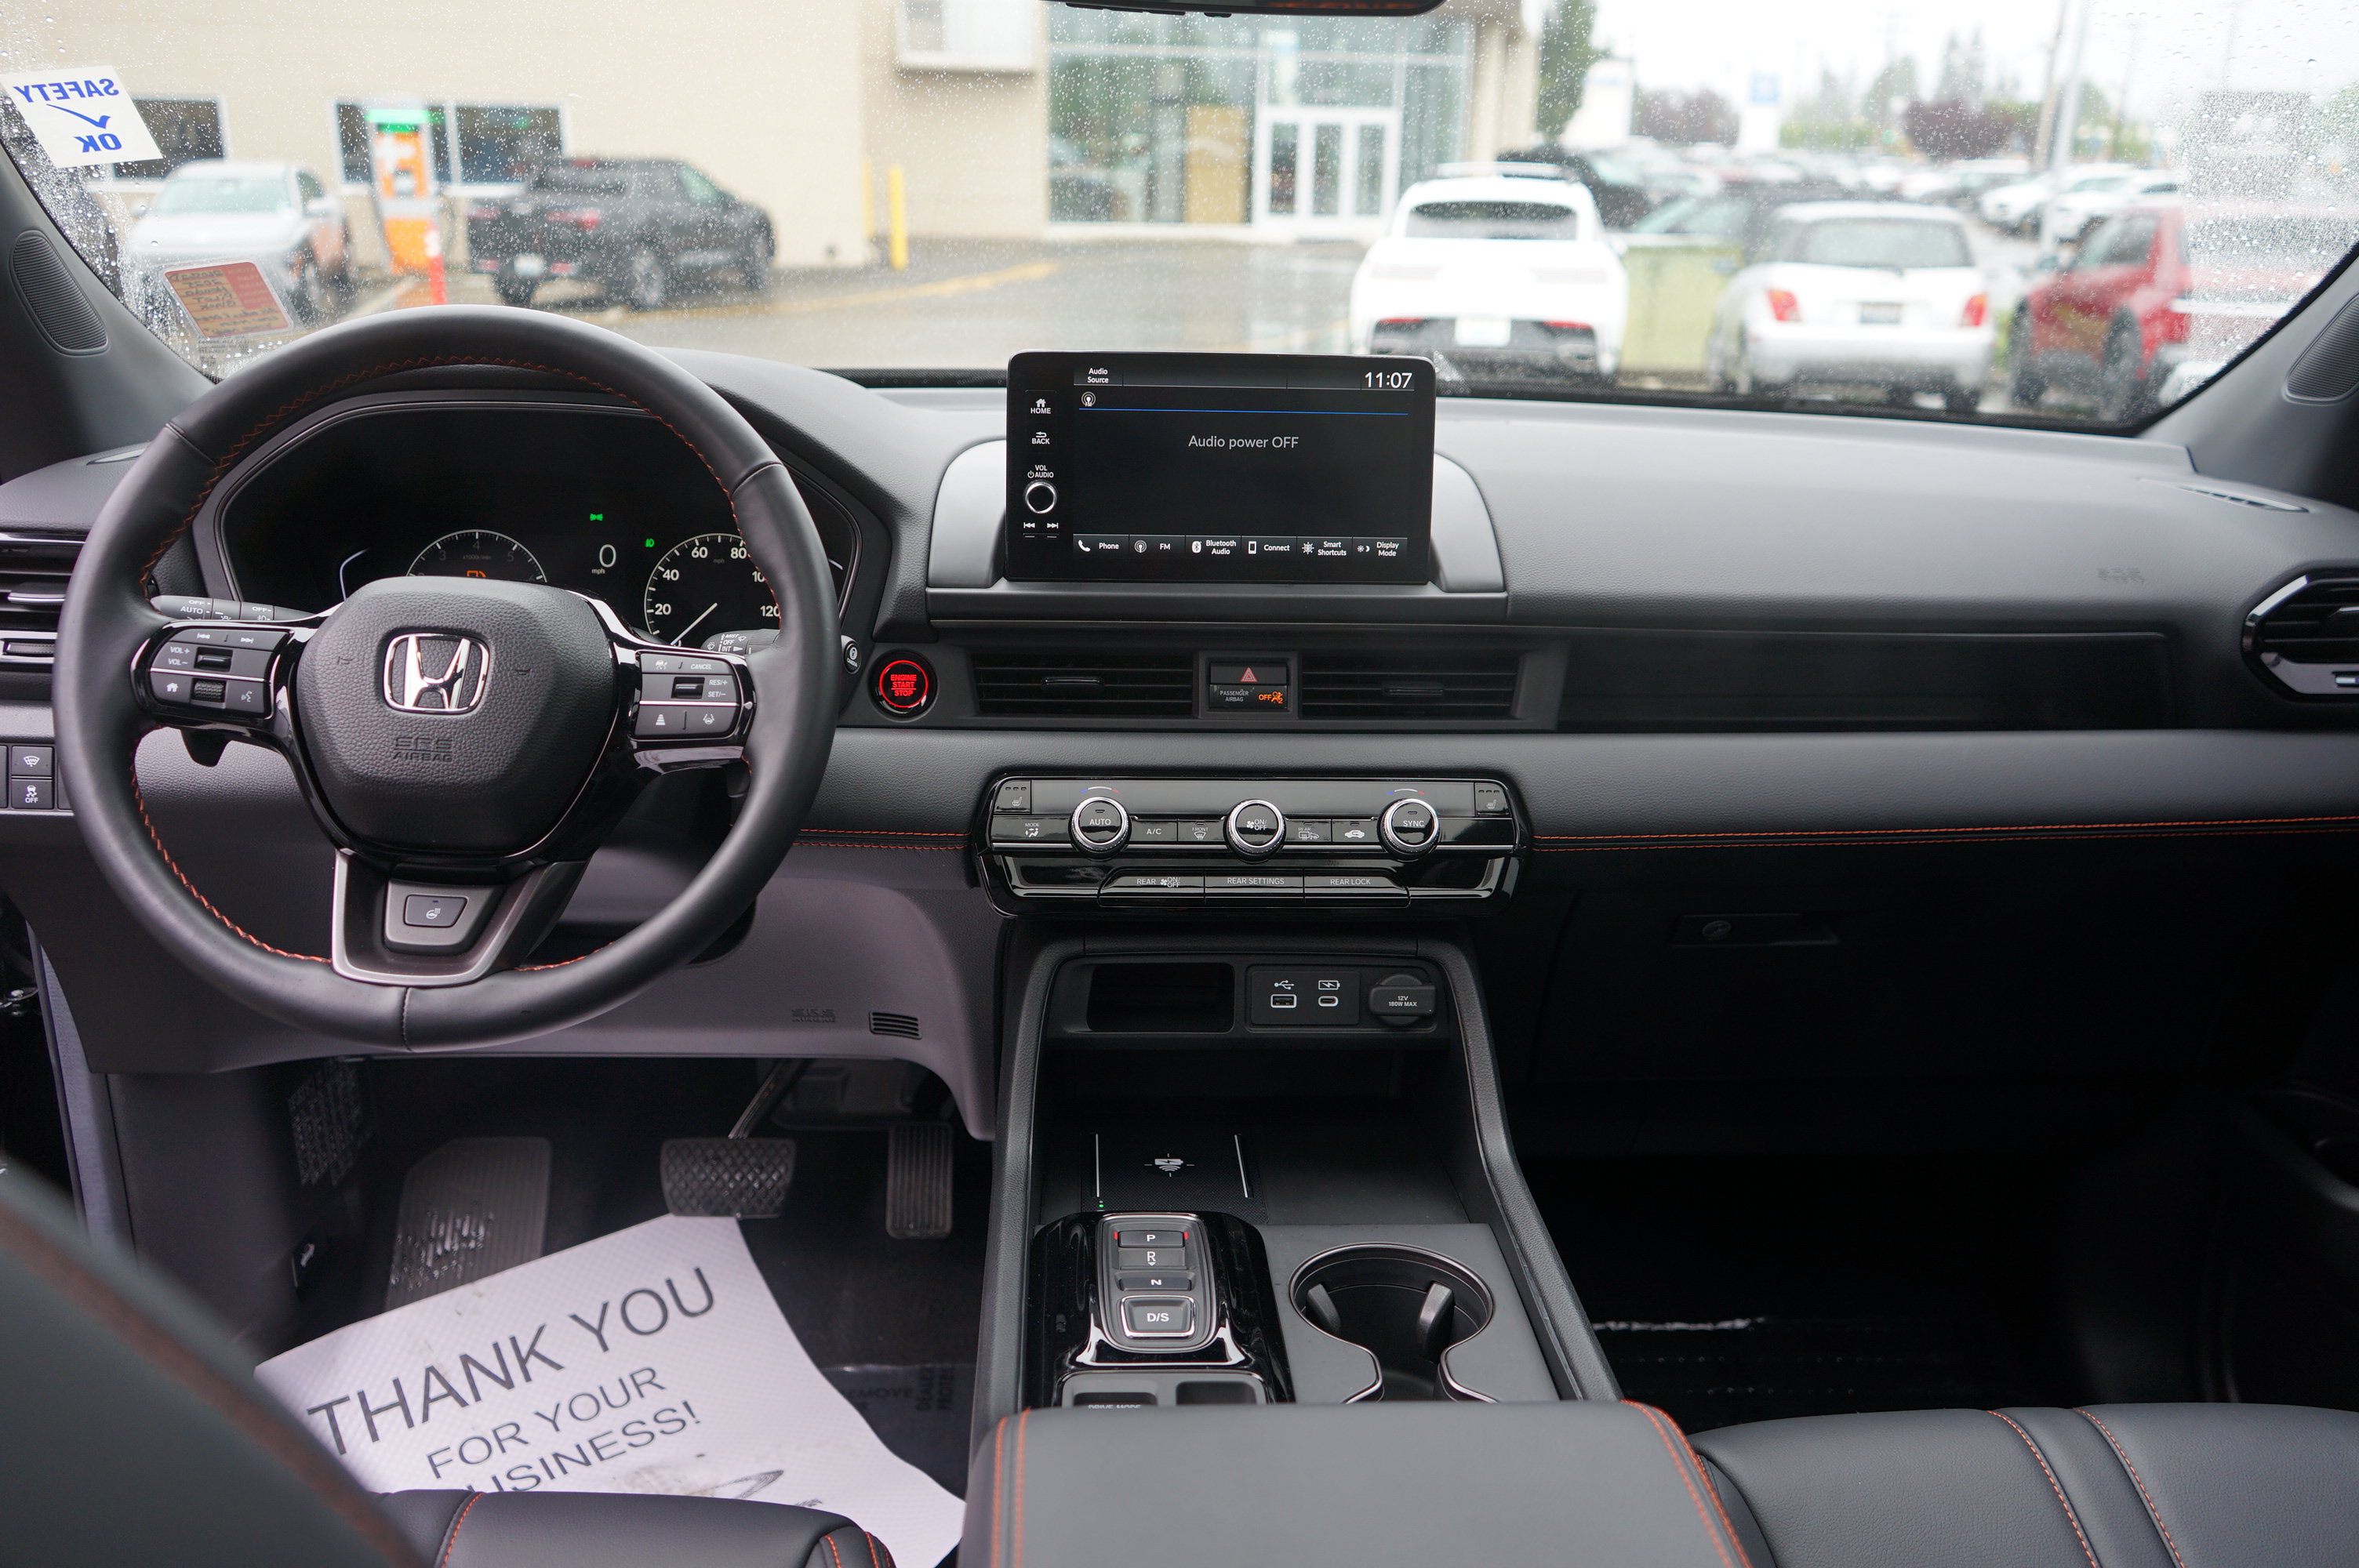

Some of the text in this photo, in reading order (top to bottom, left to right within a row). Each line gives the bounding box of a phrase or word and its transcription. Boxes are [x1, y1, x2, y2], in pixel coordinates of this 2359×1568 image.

[1365, 372, 1413, 389] 11:07
[1188, 435, 1299, 450] Audio power OFF
[1205, 539, 1237, 548] Bluetooth
[1376, 541, 1399, 550] Display
[599, 544, 616, 568] 0
[691, 547, 708, 558] 60
[730, 547, 747, 559] 80
[663, 569, 680, 581] 40
[655, 604, 671, 615] 20
[760, 605, 780, 617] 120
[392, 752, 453, 763] AIRBAG
[1147, 1251, 1156, 1261] R
[1147, 1312, 1169, 1323] D/S
[307, 1267, 715, 1456] THANK YOU
[427, 1367, 667, 1479] FOR YOUR
